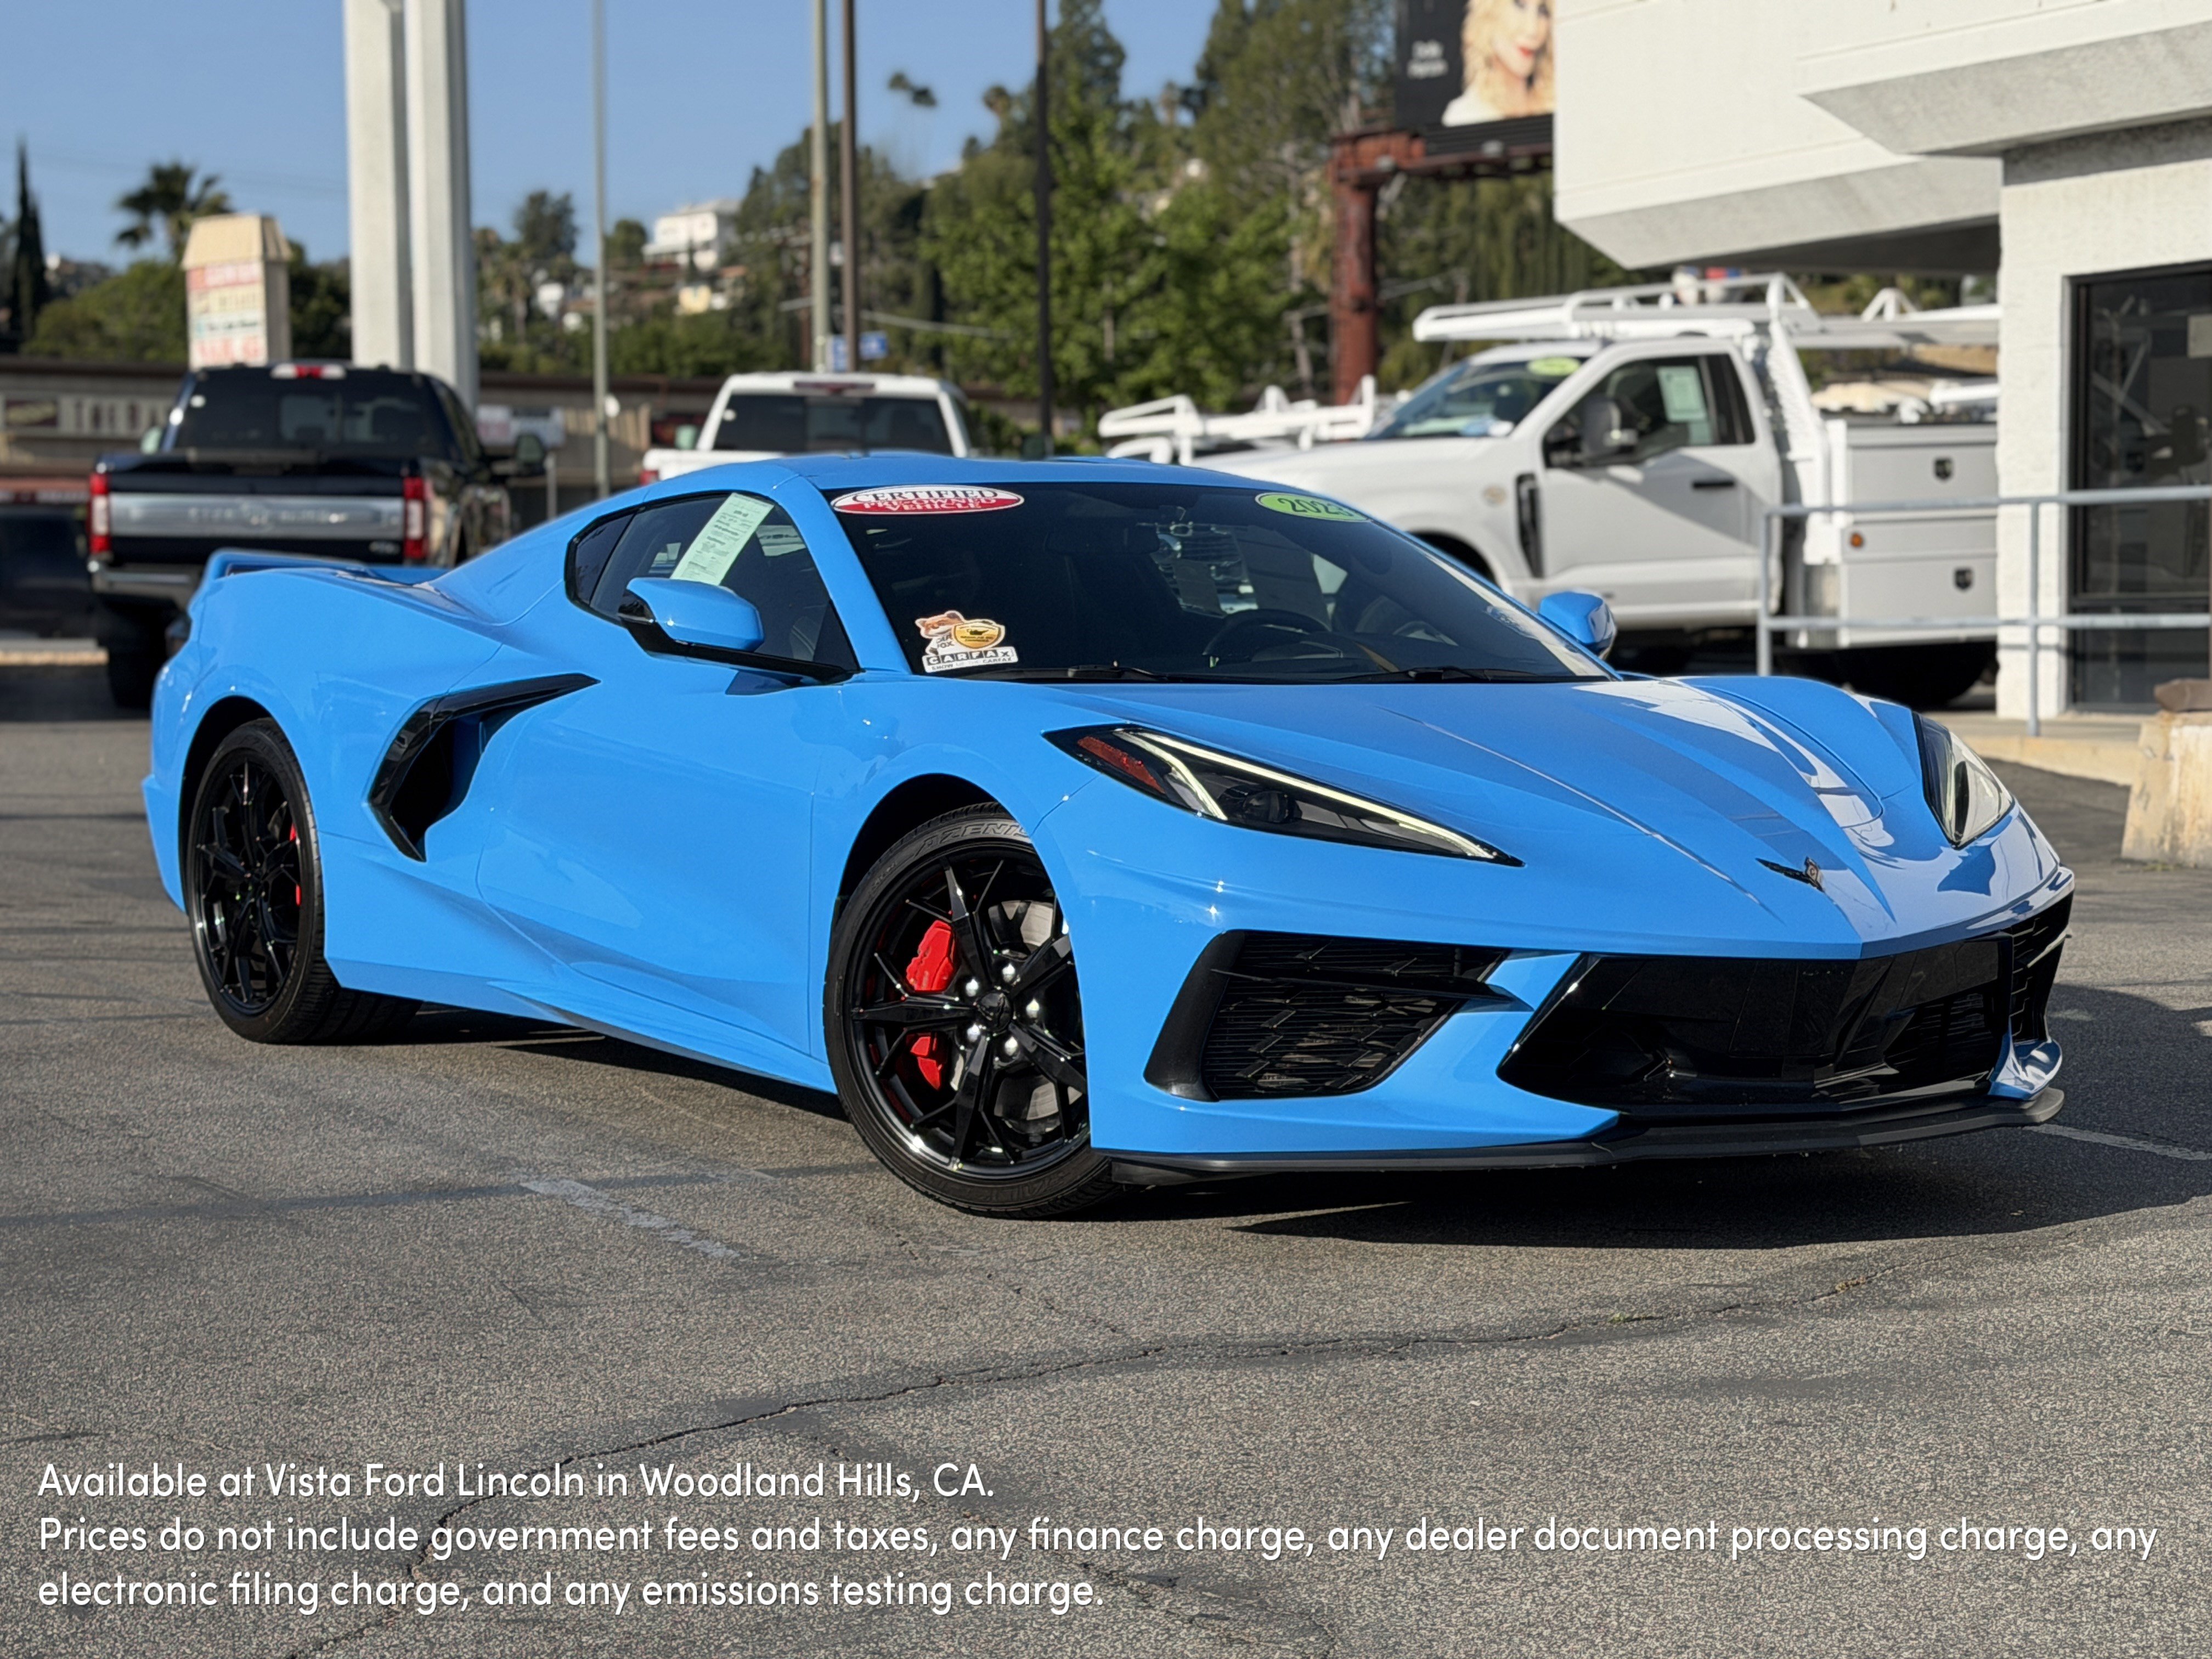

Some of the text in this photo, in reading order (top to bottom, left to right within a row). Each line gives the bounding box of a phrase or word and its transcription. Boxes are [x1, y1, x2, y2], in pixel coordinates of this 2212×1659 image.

[852, 489, 998, 503] CERTIFIED
[862, 498, 996, 509] PRE-OWNED
[885, 501, 981, 511] VEHICLE
[927, 650, 1011, 665] CARFAX
